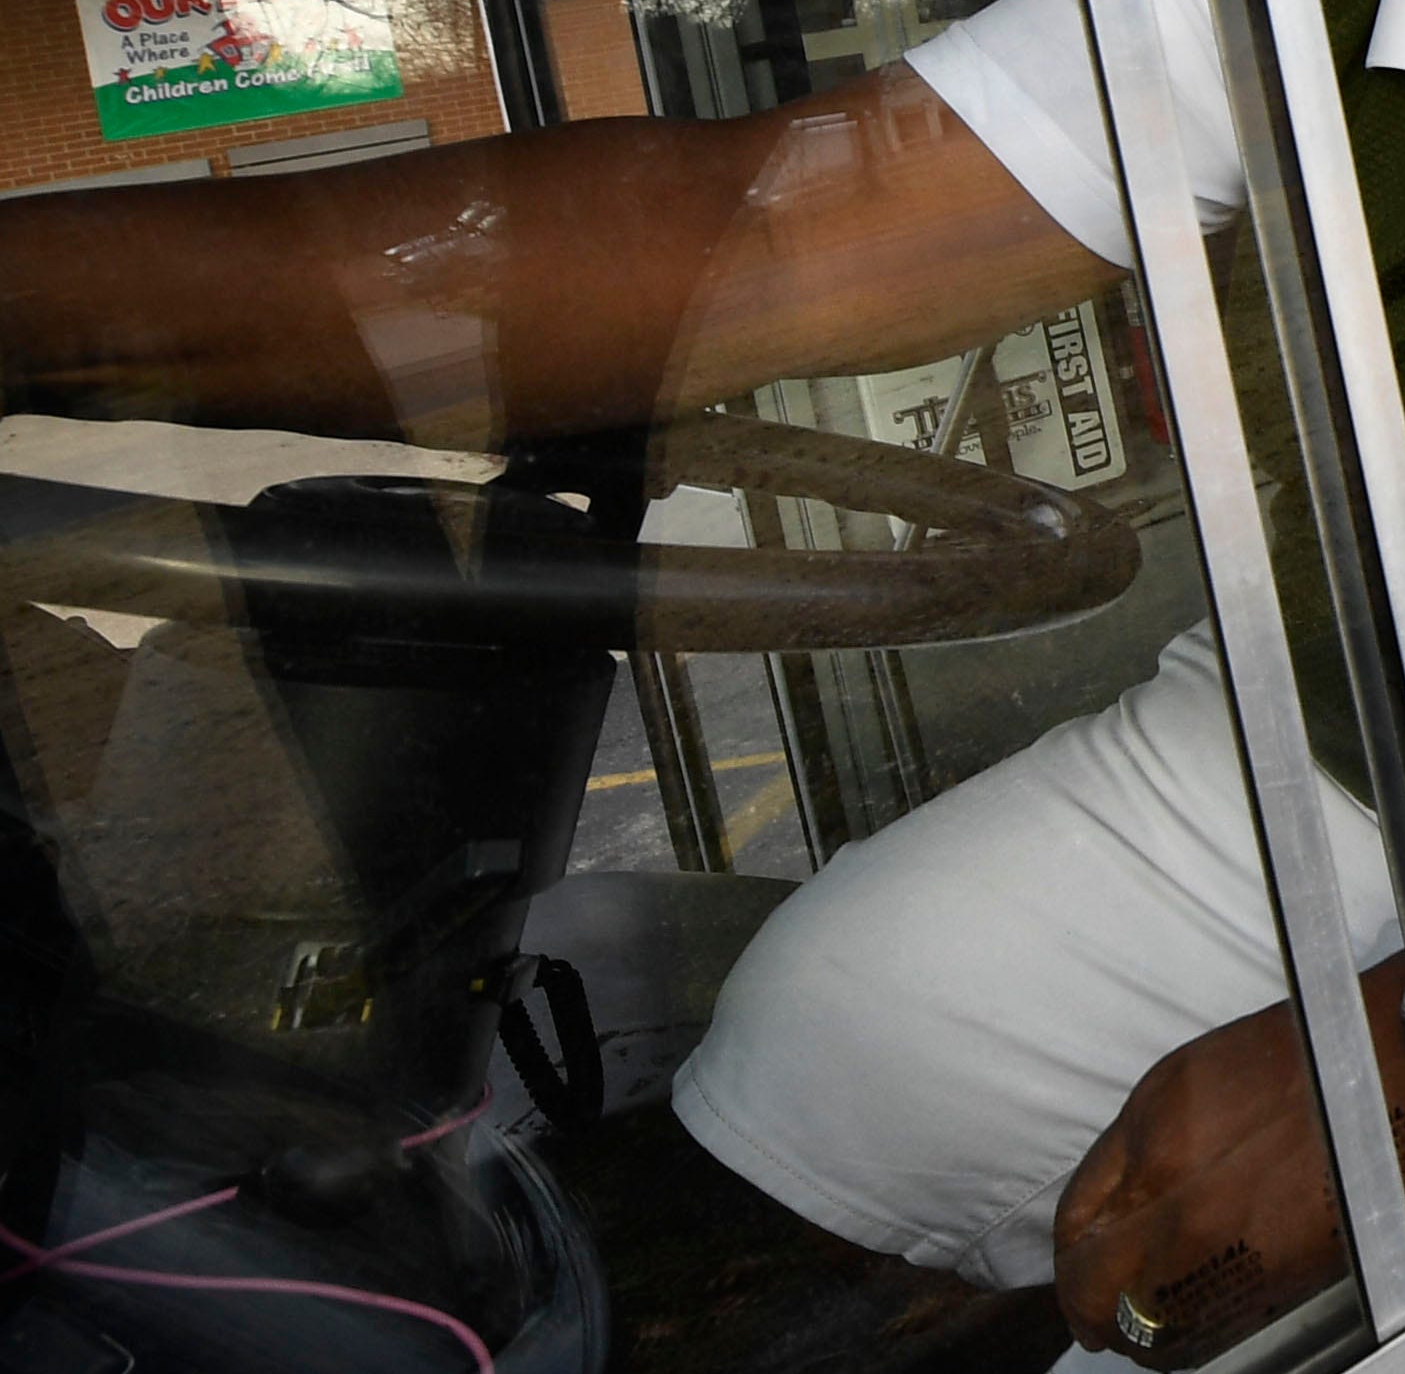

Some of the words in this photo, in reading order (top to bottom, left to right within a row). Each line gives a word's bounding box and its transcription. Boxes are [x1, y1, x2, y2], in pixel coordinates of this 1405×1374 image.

[121, 34, 136, 49] A
[140, 30, 191, 48] Place
[126, 46, 191, 65] Where
[124, 76, 230, 104] Children
[234, 67, 301, 88] Come
[1067, 409, 1108, 469] AID
